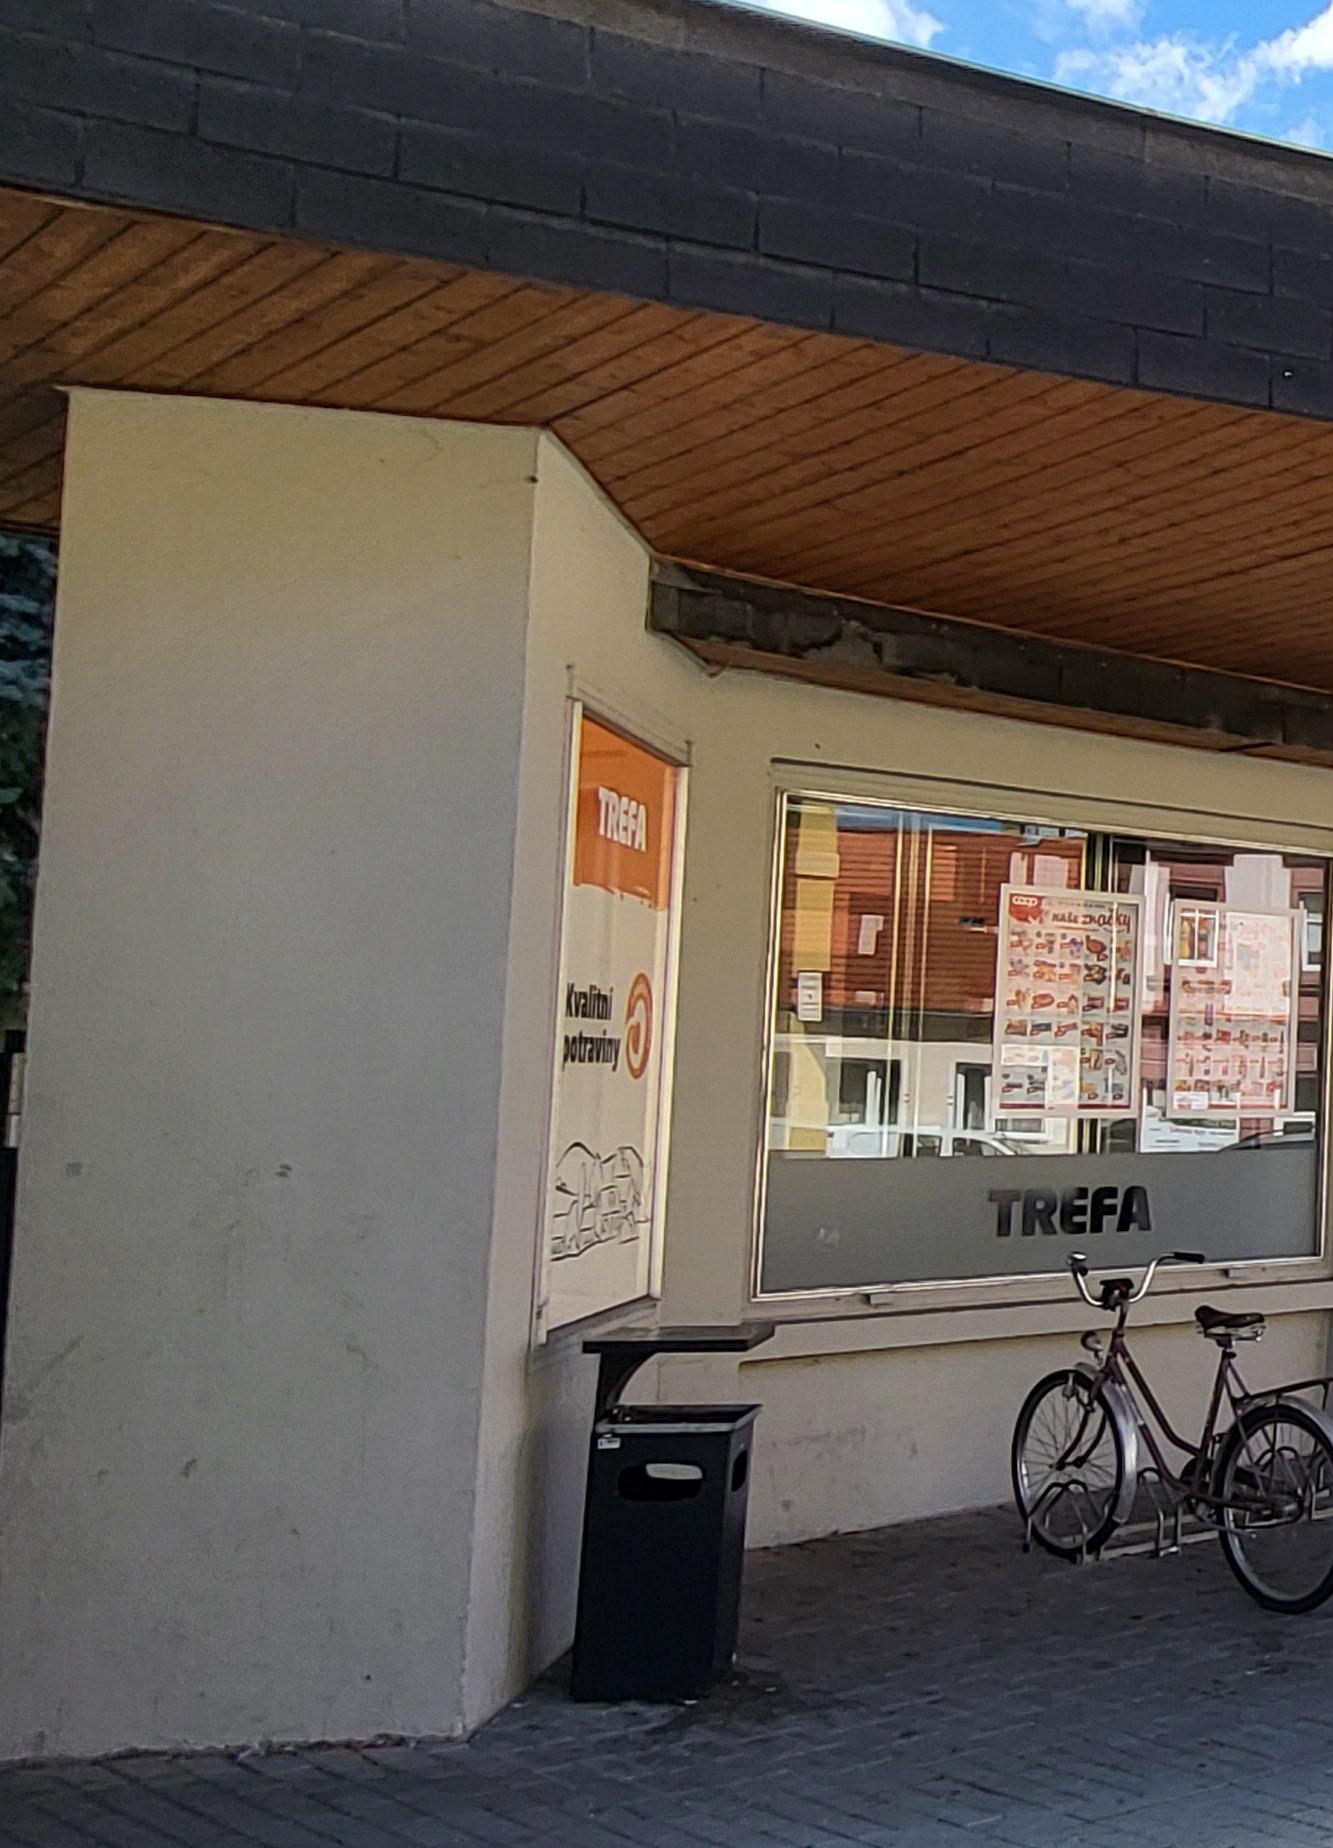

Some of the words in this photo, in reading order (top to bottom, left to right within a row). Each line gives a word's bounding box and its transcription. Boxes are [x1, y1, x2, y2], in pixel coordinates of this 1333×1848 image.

[597, 784, 647, 853] TREFA
[564, 982, 615, 1022] Kvalitní
[562, 1029, 622, 1073] potraviny
[988, 1185, 1152, 1238] TREFA
